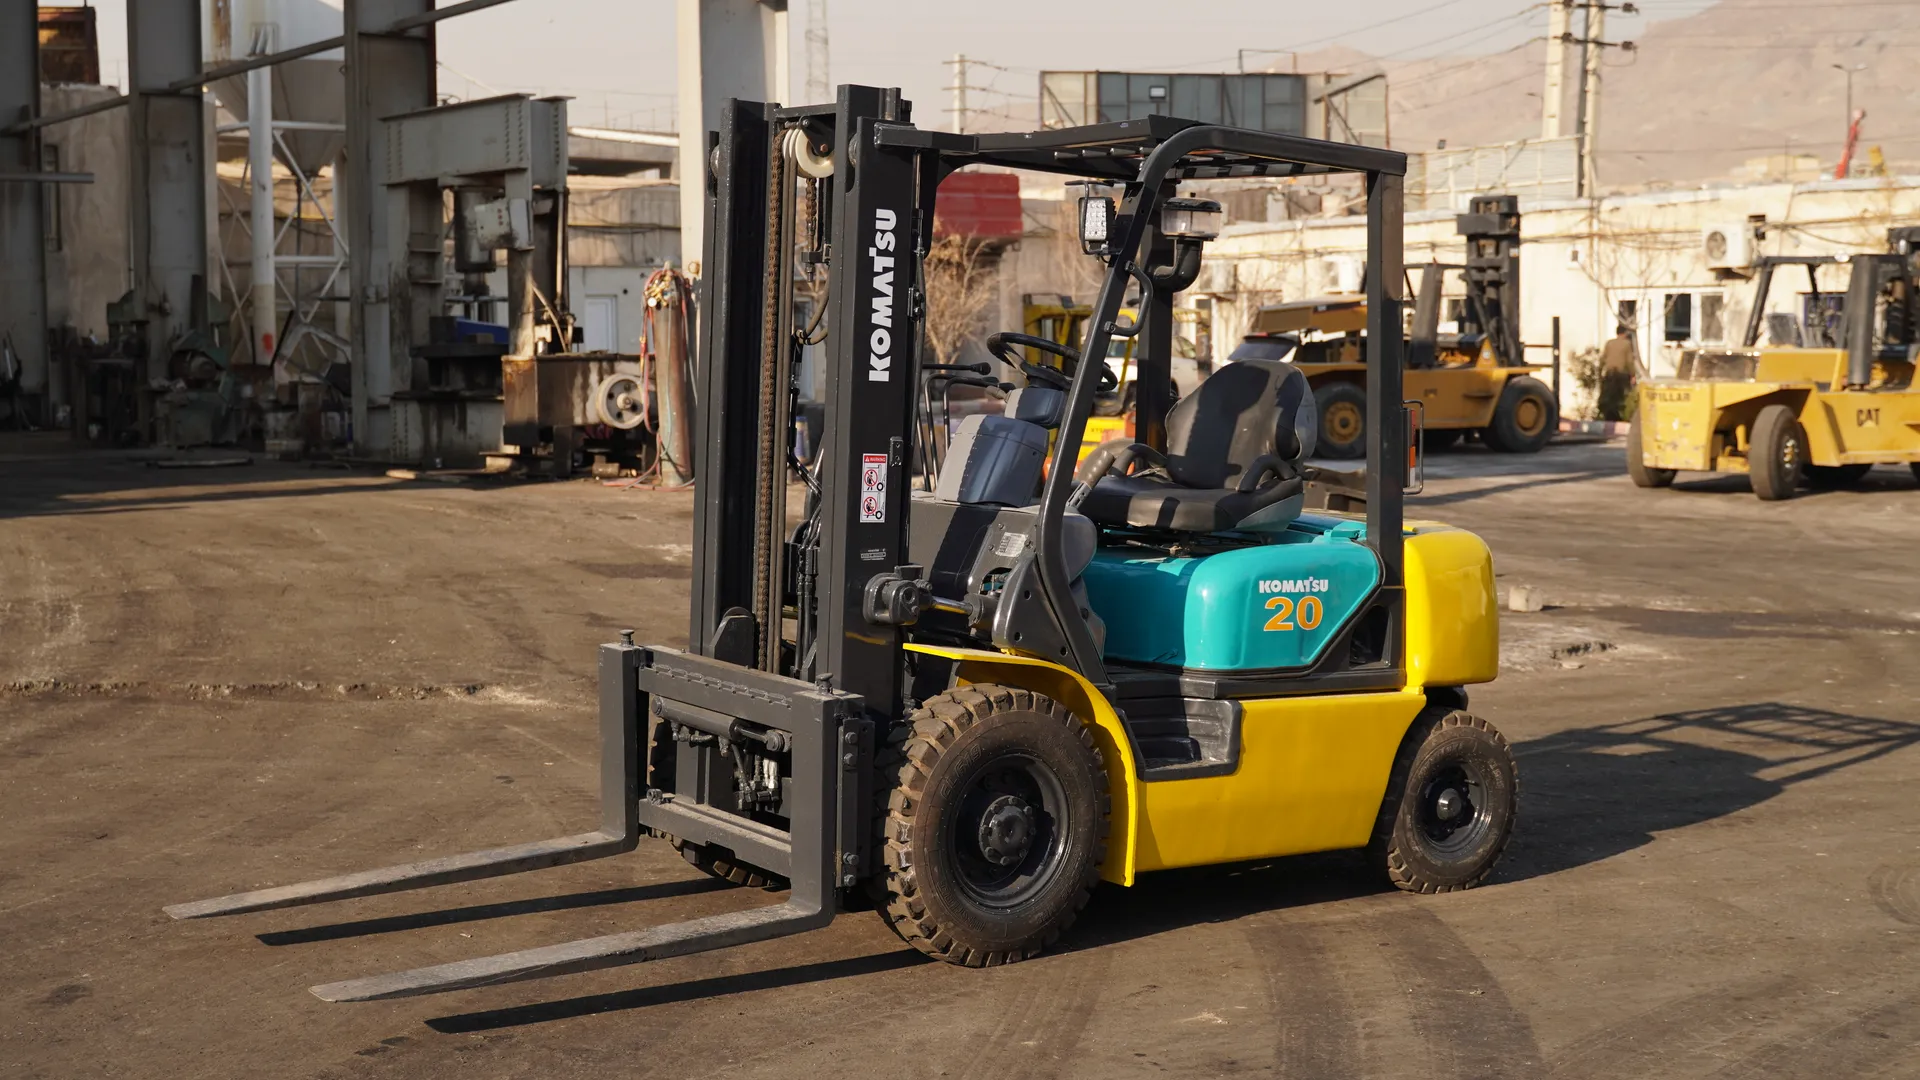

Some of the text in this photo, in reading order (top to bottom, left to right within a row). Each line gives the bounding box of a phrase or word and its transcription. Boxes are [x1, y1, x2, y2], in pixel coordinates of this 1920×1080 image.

[868, 208, 897, 382] KOMATSU
[1856, 408, 1880, 427] CAT
[1259, 576, 1329, 593] KOMATSU
[1263, 595, 1323, 631] 20
